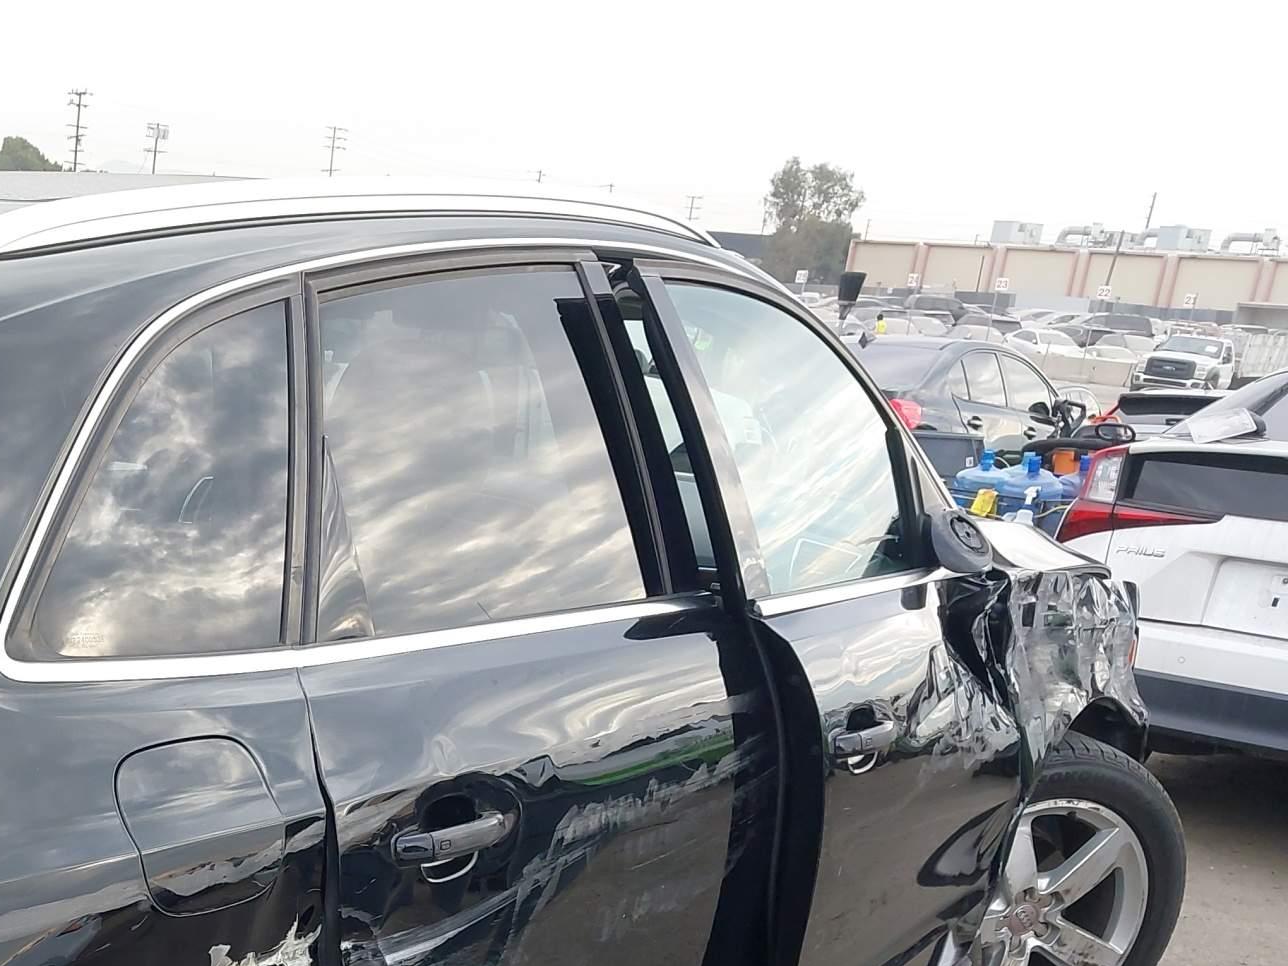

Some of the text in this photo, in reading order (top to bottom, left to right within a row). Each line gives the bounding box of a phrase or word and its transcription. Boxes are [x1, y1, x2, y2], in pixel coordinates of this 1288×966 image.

[997, 280, 1008, 289] 23
[1098, 288, 1111, 297] 22
[1116, 545, 1166, 558] PRIUS
